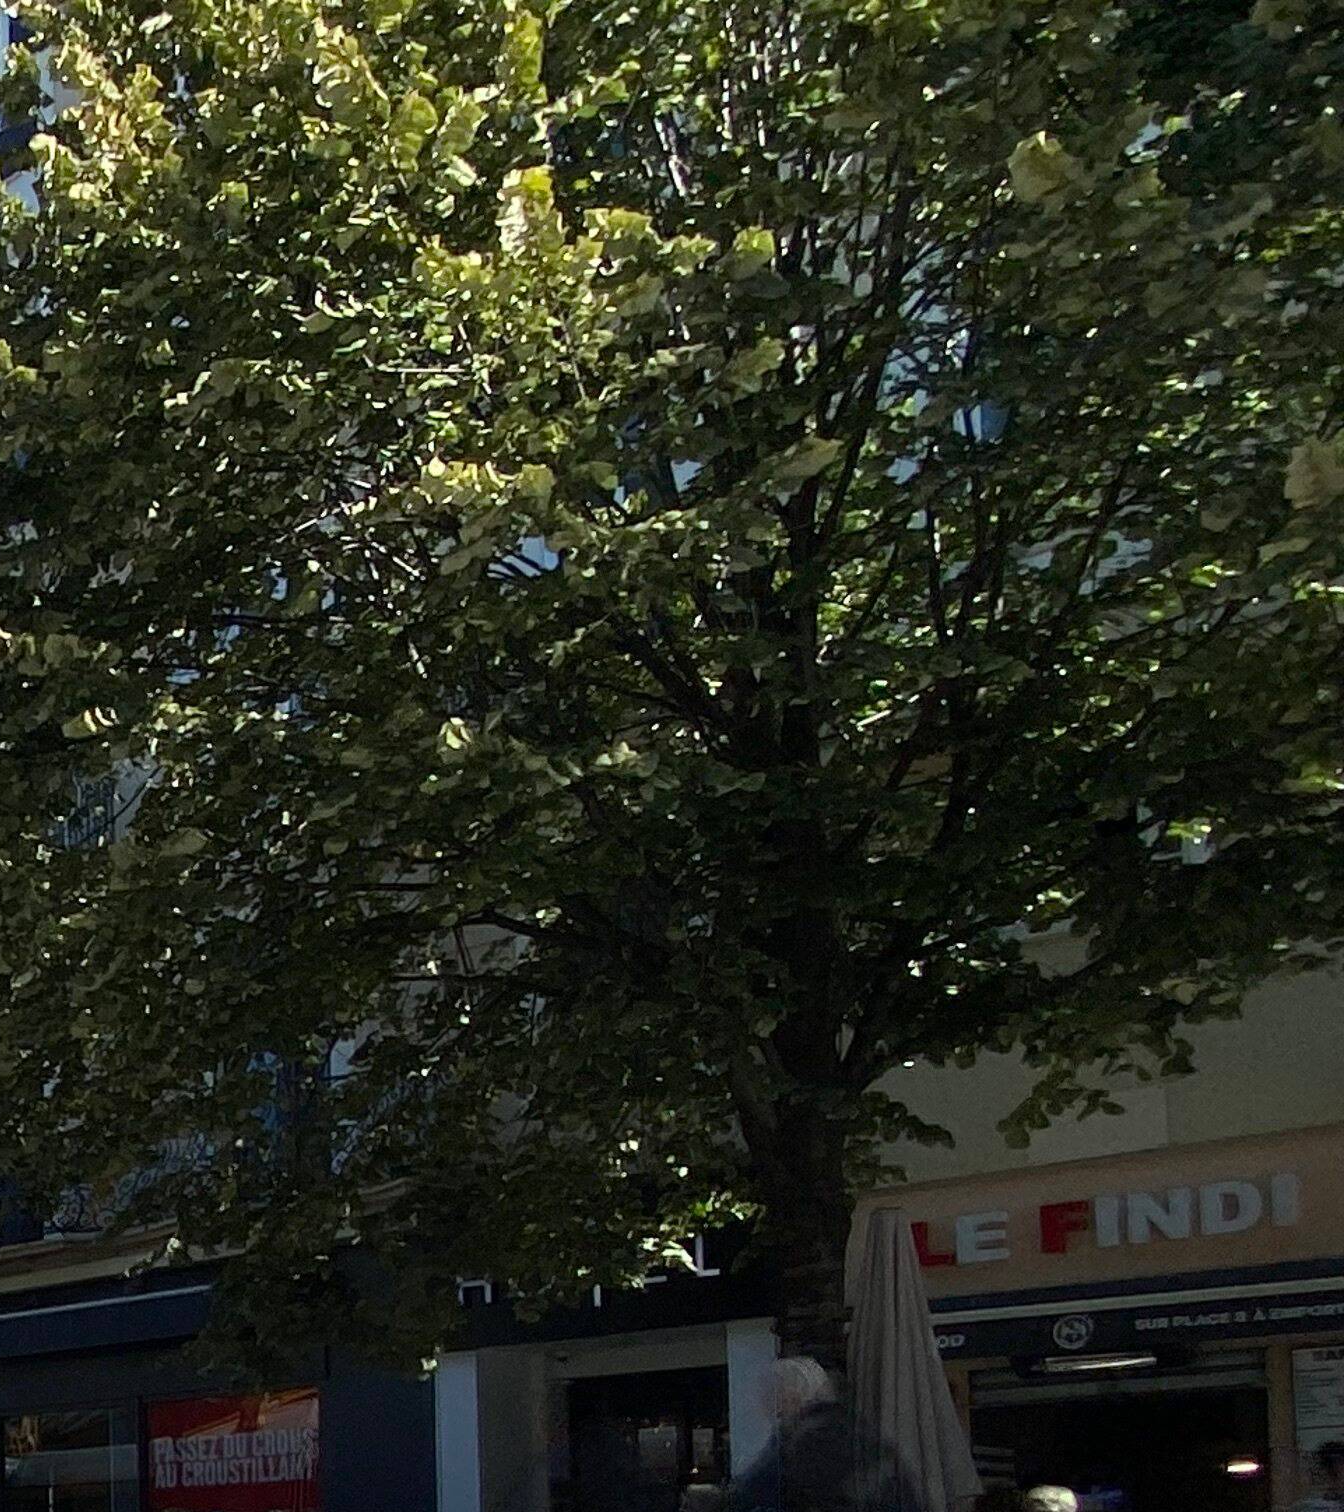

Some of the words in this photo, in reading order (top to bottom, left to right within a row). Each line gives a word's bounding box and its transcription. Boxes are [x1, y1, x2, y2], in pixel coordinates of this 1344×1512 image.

[912, 1209, 1011, 1267] LE
[1039, 1172, 1303, 1255] FINDI
[151, 1433, 219, 1464] PASSEZ
[222, 1431, 249, 1459] DU
[154, 1462, 177, 1489] AU
[181, 1454, 316, 1487] CROUSTILLANT
